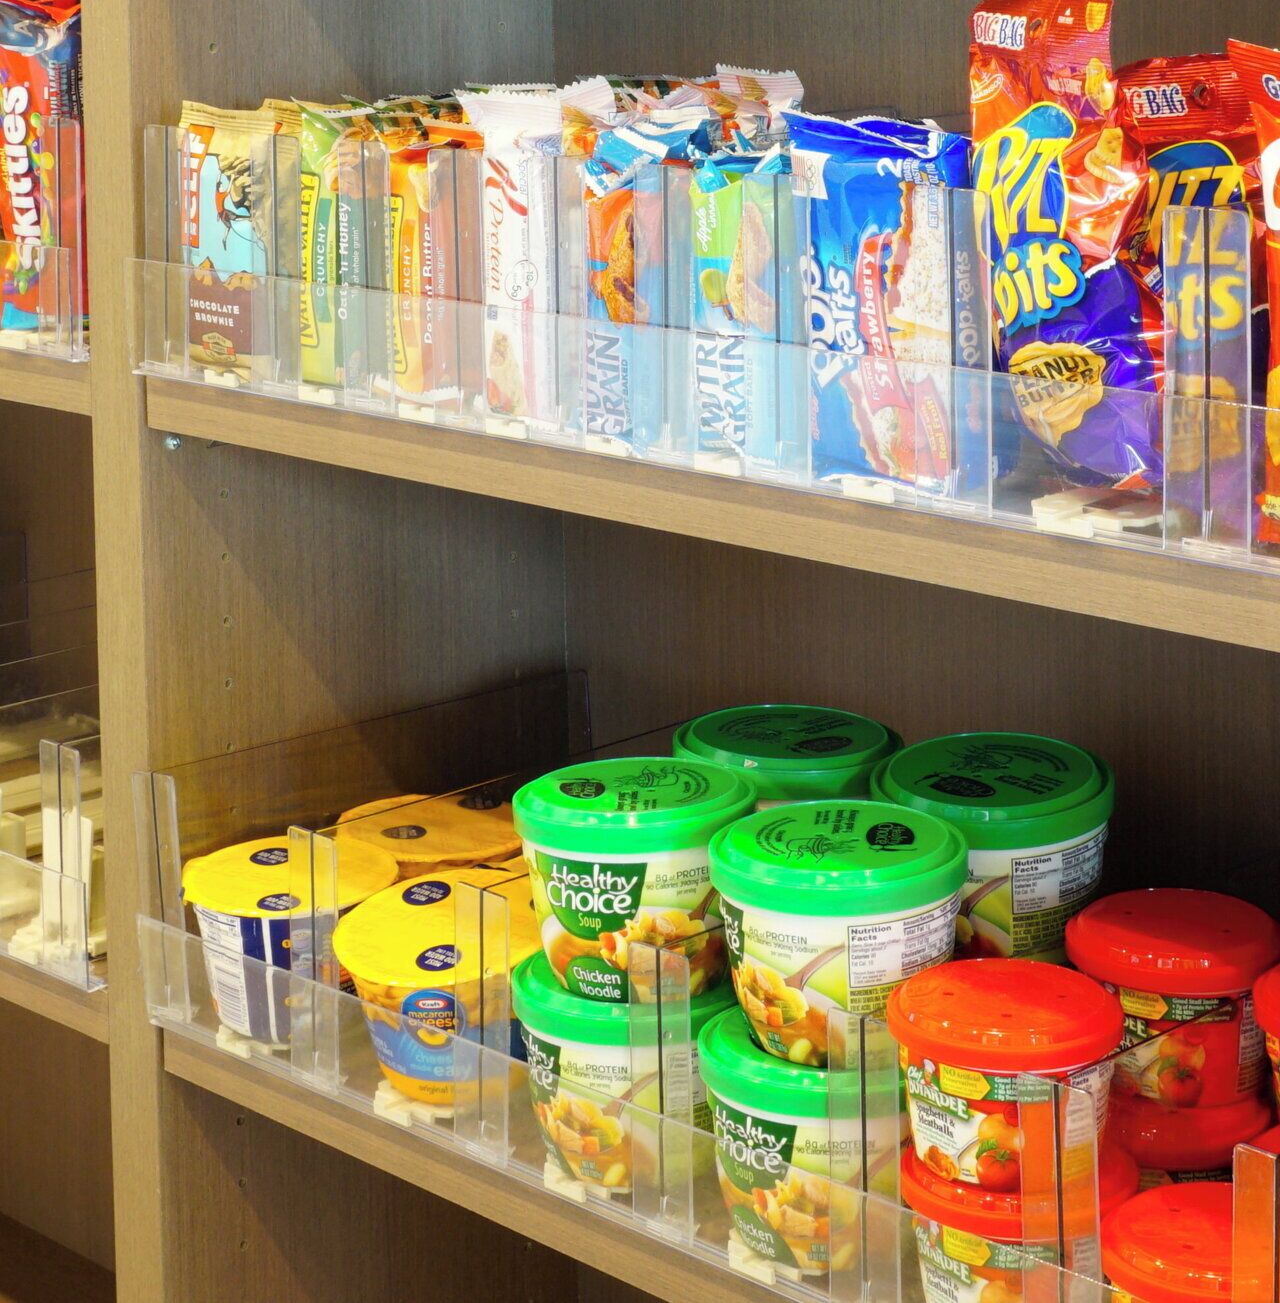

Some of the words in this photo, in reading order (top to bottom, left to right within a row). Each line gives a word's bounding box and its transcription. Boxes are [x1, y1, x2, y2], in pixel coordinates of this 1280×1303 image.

[975, 14, 997, 44] BIG
[998, 18, 1025, 49] BAG
[1144, 87, 1185, 115] BAG
[517, 159, 528, 195] Special
[877, 157, 902, 177] 2
[338, 202, 351, 255] Honey
[695, 207, 712, 252] Apple
[488, 199, 504, 293] Protein
[316, 223, 326, 297] CRUNCHY
[403, 245, 412, 320] CRUNCHY
[189, 298, 240, 315] CHOCOLATE
[195, 312, 235, 327] BROWNIE
[861, 251, 893, 390] Strawberry
[594, 333, 626, 435] GRAIN
[718, 336, 746, 447] GRAIN
[1013, 856, 1052, 867] Nutrition
[1013, 864, 1040, 873] Facts
[551, 863, 639, 896] Healthy
[546, 881, 632, 914] Choice
[578, 914, 602, 930] Soup
[850, 924, 892, 936] Nutrition
[765, 931, 808, 945] PROTEIN
[851, 932, 878, 943] Facts
[573, 967, 621, 985] Chicken
[579, 981, 621, 999] Noodle
[408, 1010, 454, 1018] macaroni
[585, 1063, 628, 1075] PROTEIN
[915, 1101, 948, 1123] Spaghetti
[715, 1105, 787, 1152] Healthy
[918, 1114, 954, 1139] Meatballs
[715, 1120, 784, 1174] Choice
[734, 1162, 754, 1184] Soup
[734, 1215, 773, 1242] Chicken
